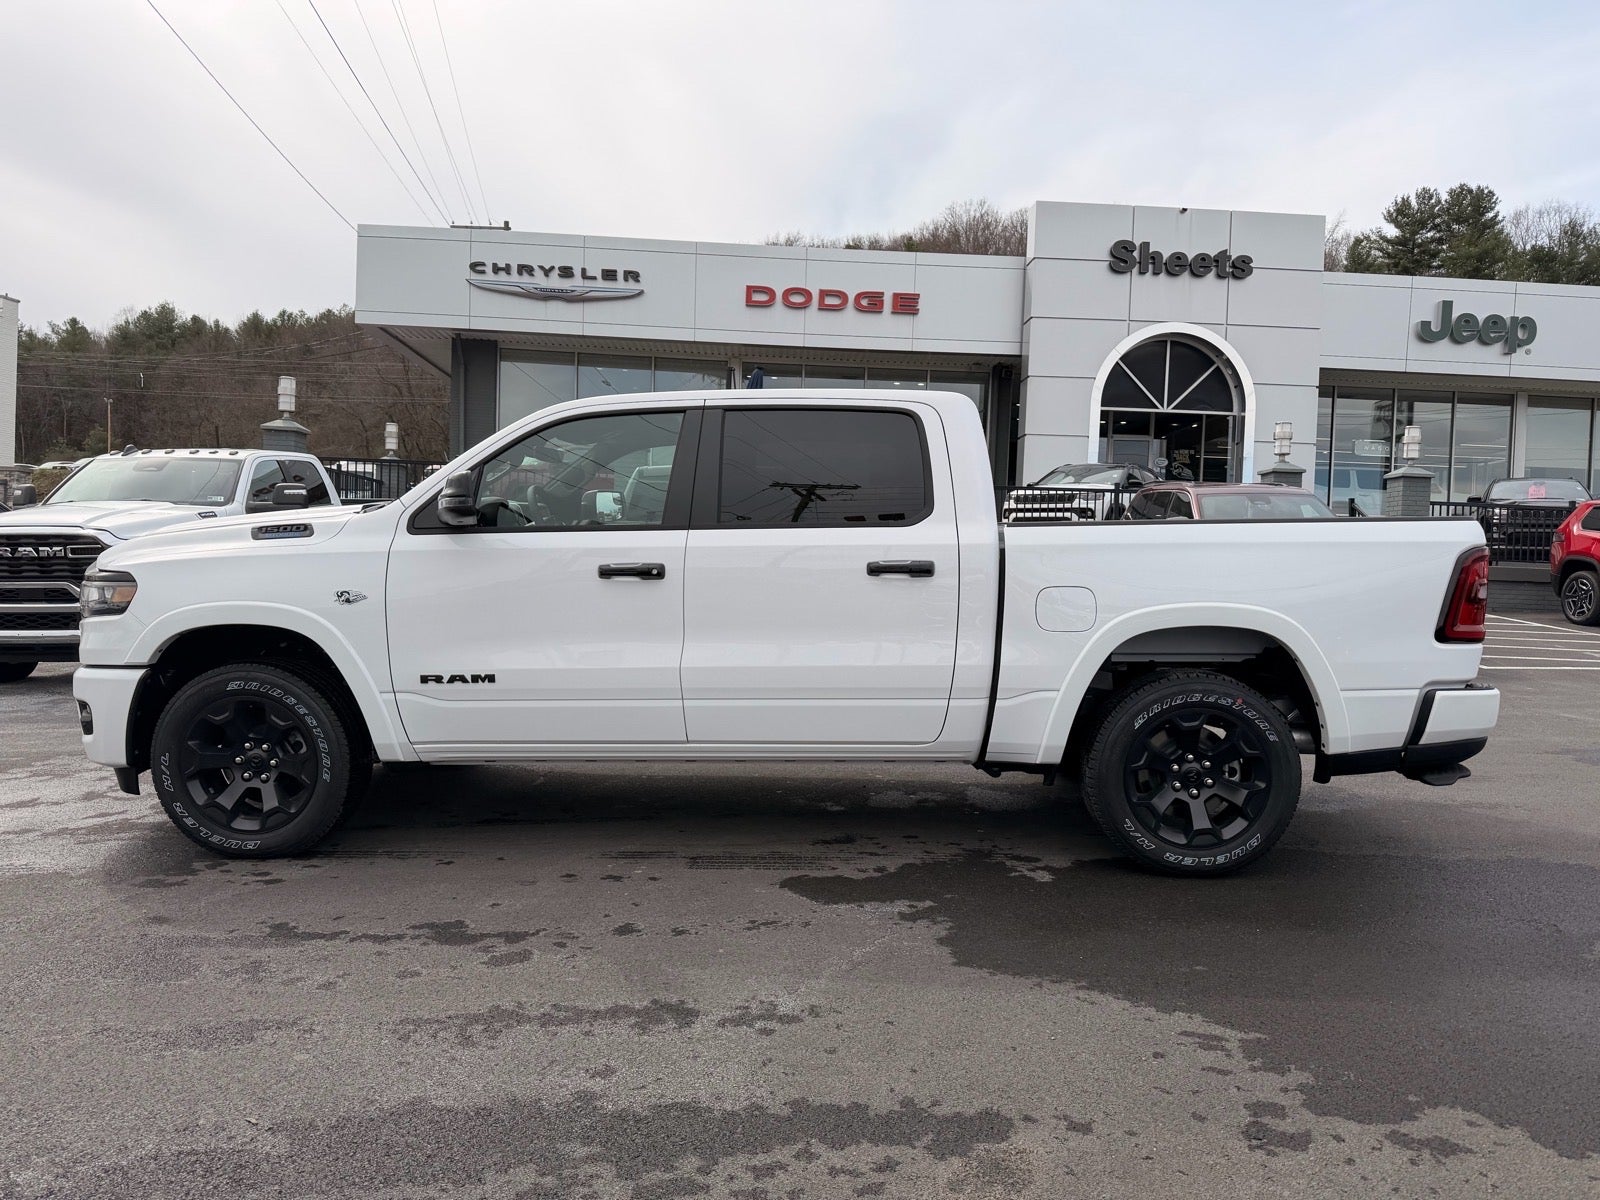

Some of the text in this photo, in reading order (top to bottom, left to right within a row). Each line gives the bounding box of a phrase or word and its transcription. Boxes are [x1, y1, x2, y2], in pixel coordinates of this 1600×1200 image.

[469, 261, 641, 283] CHRYSLER
[1109, 239, 1254, 279] Sheets
[745, 285, 921, 315] DODGE
[1416, 299, 1538, 355] Jeep
[261, 525, 305, 533] 1500
[420, 674, 496, 684] RAM
[226, 681, 331, 782] BRIDGESTONE
[1134, 693, 1279, 742] BRIDGESTONE
[173, 802, 261, 850] DUELER
[1163, 833, 1261, 866] DUELER
